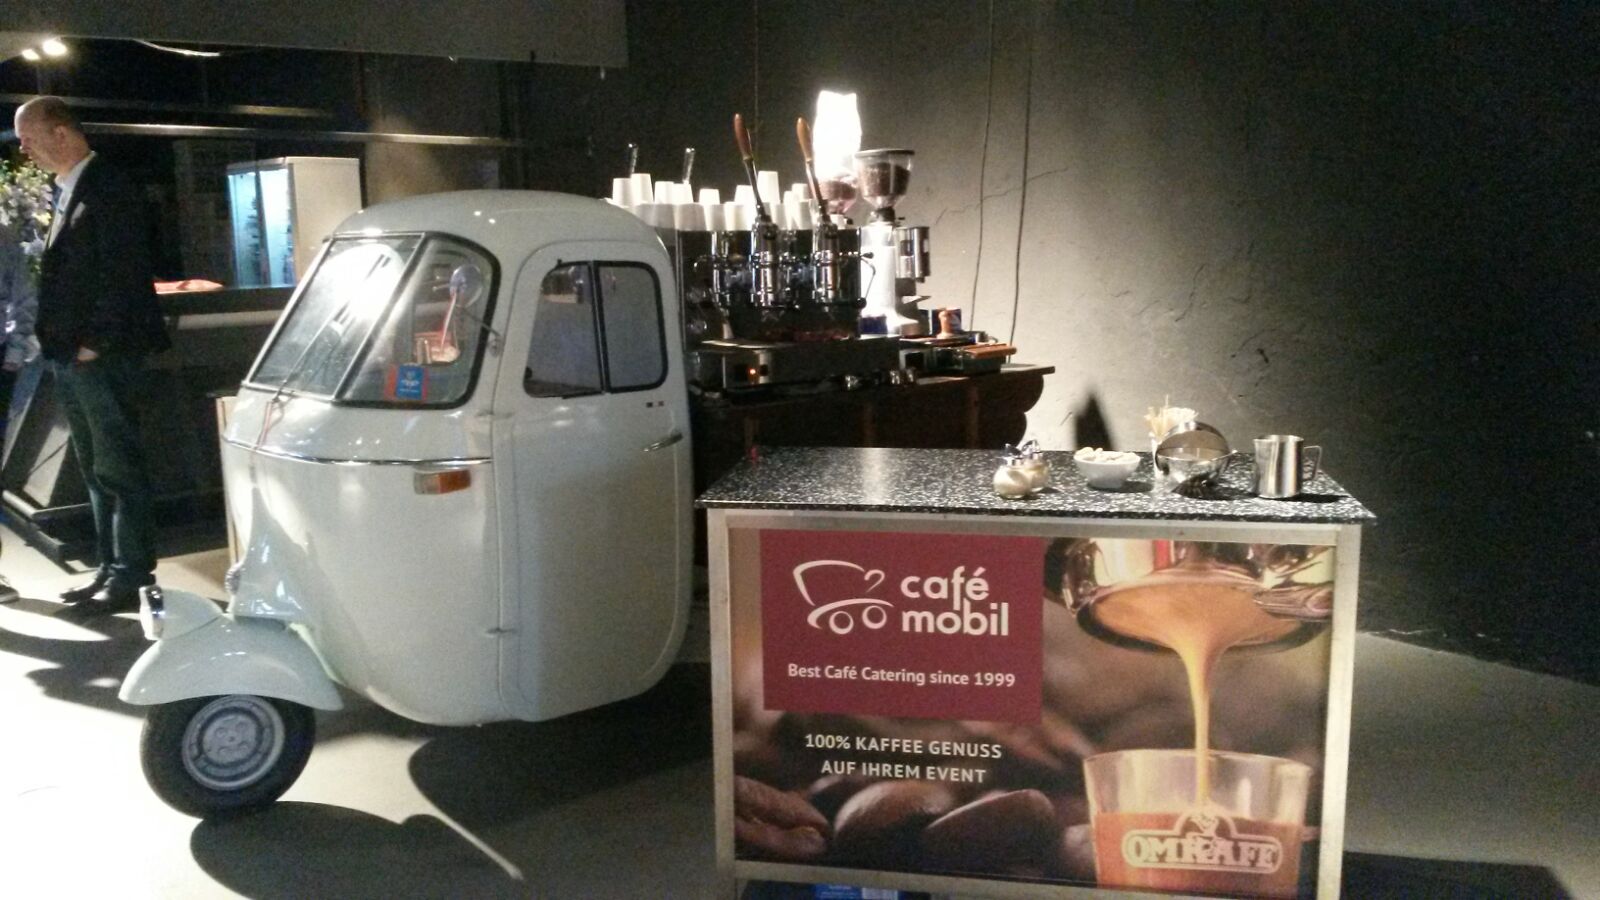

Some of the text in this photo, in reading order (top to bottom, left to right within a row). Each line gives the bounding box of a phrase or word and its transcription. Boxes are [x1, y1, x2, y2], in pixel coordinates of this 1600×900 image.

[900, 565, 990, 611] café
[902, 598, 1009, 636] mobil
[788, 663, 1016, 687] Best Café Catering since 1999
[805, 733, 1003, 759] 100% KAFFEE GENUSS
[821, 760, 987, 783] AUF IHREM EVENT
